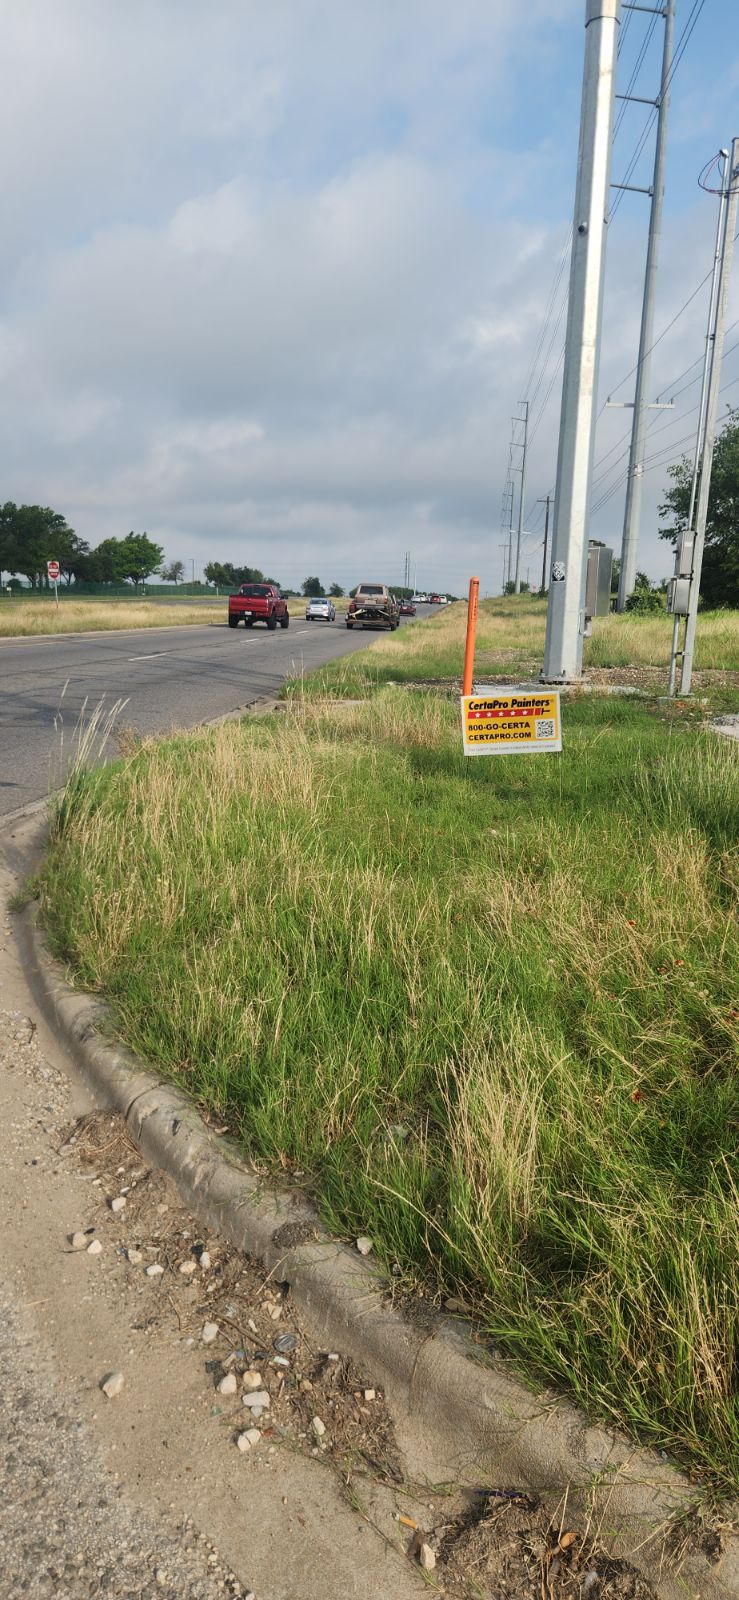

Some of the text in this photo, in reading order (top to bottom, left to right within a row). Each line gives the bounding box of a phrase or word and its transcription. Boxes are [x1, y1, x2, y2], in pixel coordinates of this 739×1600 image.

[469, 698, 550, 710] CertaPro Painters
[469, 722, 530, 731] 800-GO-CERTA
[469, 732, 531, 741] CERTAPRO.COM
